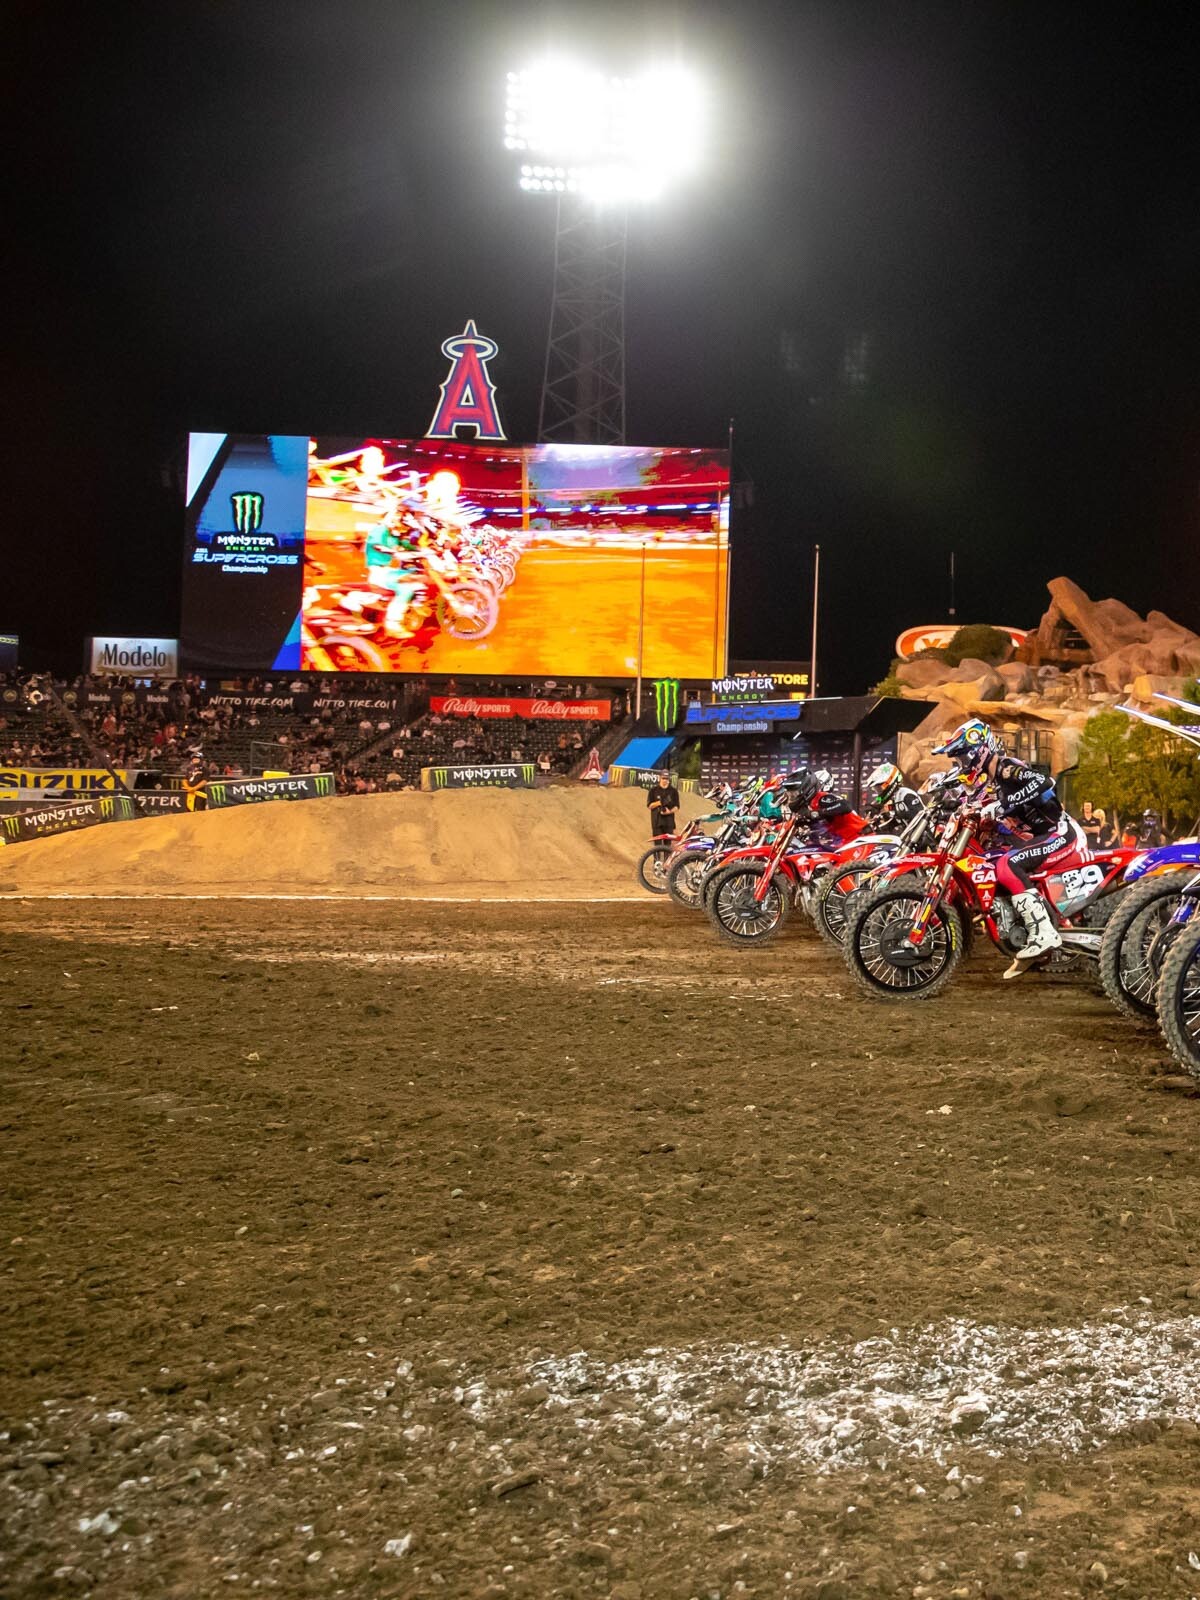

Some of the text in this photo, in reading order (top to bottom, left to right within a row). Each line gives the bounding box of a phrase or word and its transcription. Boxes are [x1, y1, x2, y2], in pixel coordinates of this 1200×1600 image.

[424, 319, 507, 440] A
[217, 535, 275, 547] MONSTER
[192, 553, 298, 564] SUPERCROSS
[222, 565, 268, 574] Championship
[104, 643, 166, 667] Modelo
[711, 677, 774, 693] MONSTER
[209, 696, 293, 708] NITTO TIRE.COM
[313, 699, 345, 708] NITTO
[482, 704, 510, 713] SPORTS
[531, 700, 599, 718] Bally SPORTS
[716, 721, 768, 733] Championship
[453, 768, 517, 781] MONSTER
[233, 781, 309, 796] MONSTER
[245, 793, 298, 801] ENERGY
[25, 804, 95, 827] MONSTER
[37, 817, 86, 832] ENERGY
[1009, 849, 1030, 864] TROY
[1030, 847, 1042, 857] LEE
